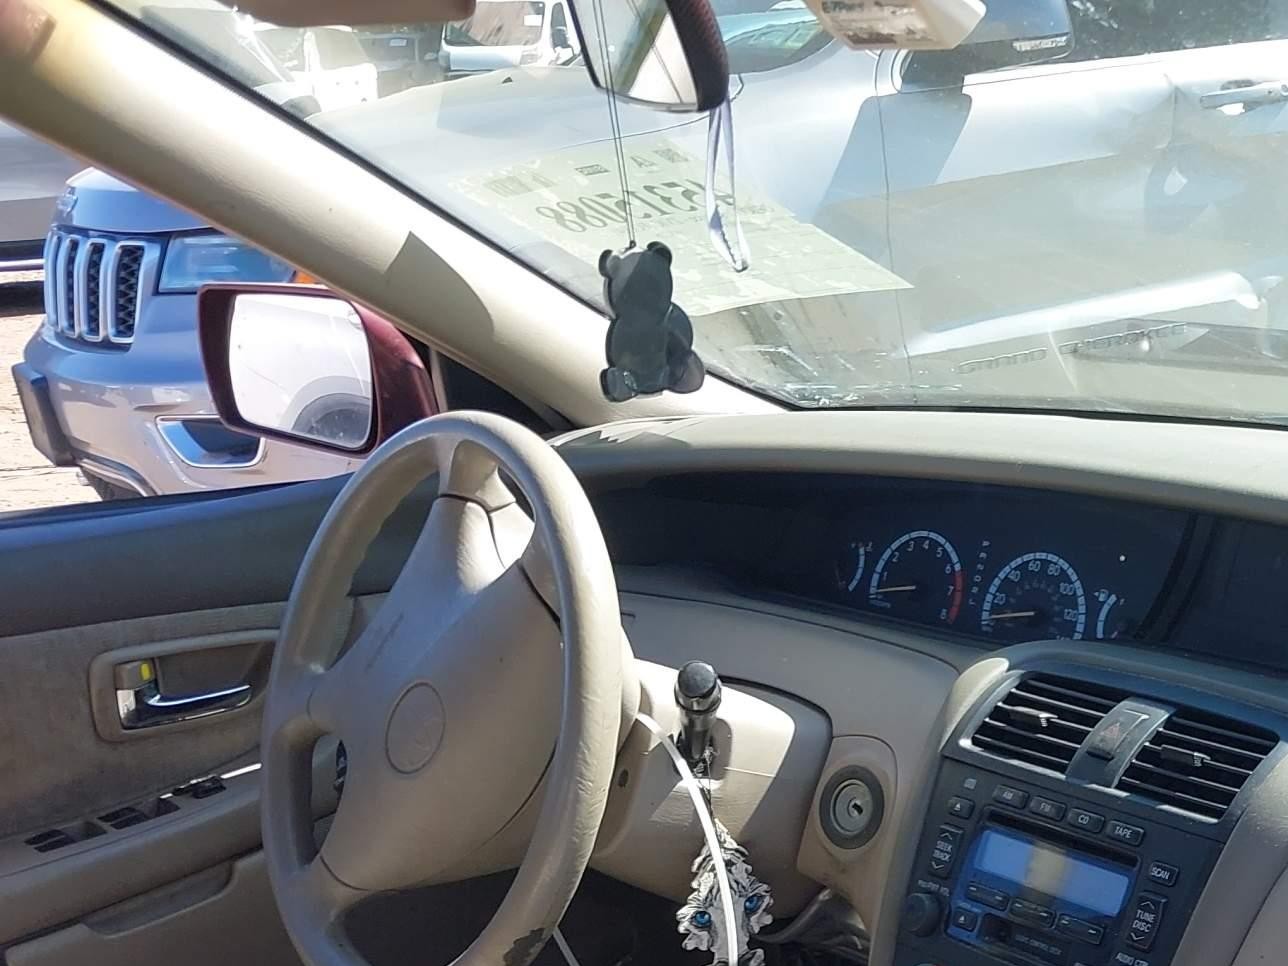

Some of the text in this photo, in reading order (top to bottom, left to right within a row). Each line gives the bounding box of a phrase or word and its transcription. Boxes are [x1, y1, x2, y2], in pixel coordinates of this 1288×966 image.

[1028, 560, 1041, 572] 60
[1047, 563, 1061, 576] 80
[1007, 570, 1021, 582] 40
[1059, 582, 1075, 595] 100
[1063, 608, 1078, 621] 120
[1078, 814, 1089, 825] CD
[1115, 826, 1132, 839] TAPE
[936, 840, 952, 851] SEEK
[1151, 866, 1170, 880] SCAN
[1136, 909, 1156, 922] TUNE
[1132, 920, 1151, 932] DISC
